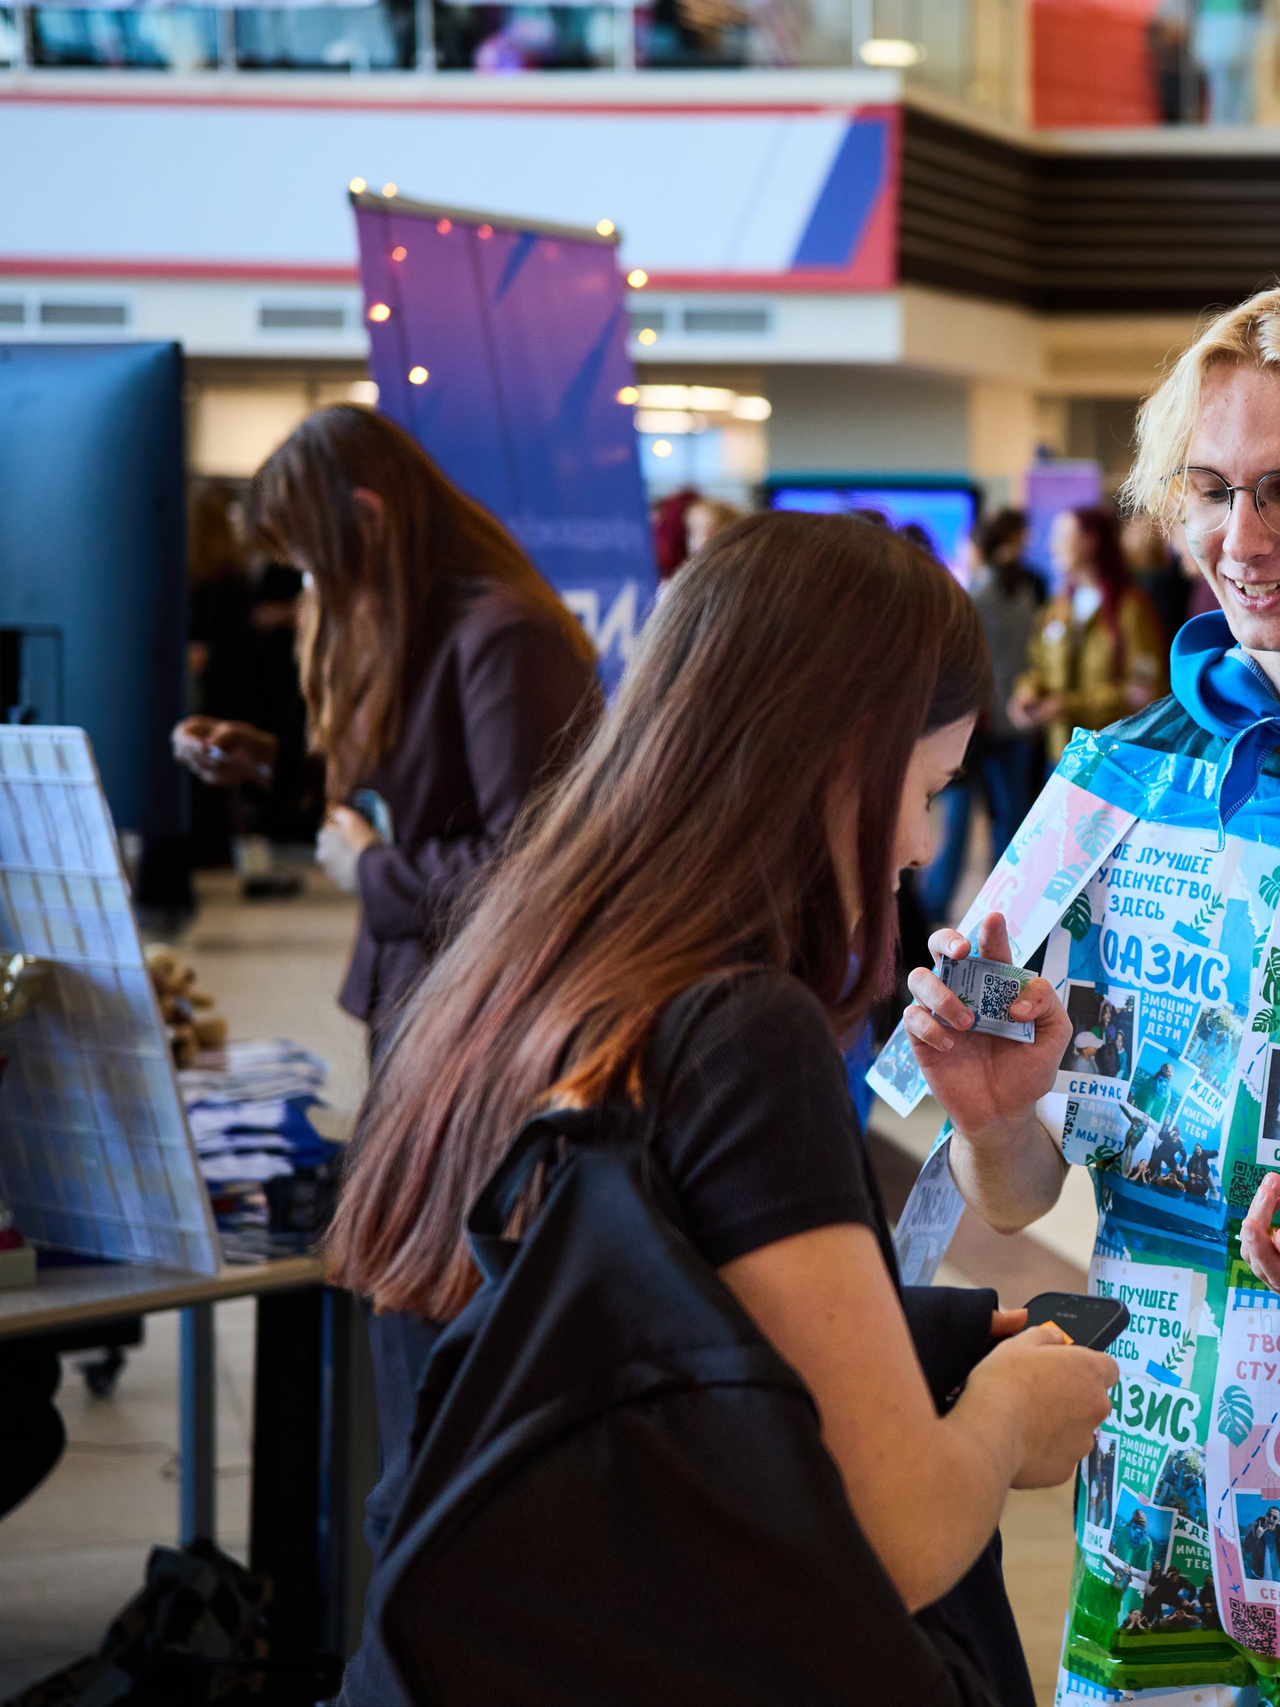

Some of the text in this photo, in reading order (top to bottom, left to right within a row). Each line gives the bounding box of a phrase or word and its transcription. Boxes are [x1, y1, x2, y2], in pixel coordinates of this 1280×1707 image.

[1111, 843, 1213, 875] ОЕ ЛУЧШЕЕ
[1098, 865, 1212, 901] УДЕНЧЕСТВО
[1109, 895, 1165, 921] ЗДЕСЬ
[1103, 929, 1223, 1001] ОАЗИС
[1141, 1005, 1190, 1029] РАБОТА
[1142, 992, 1194, 1017] ЭМОЦИИ
[1145, 1022, 1182, 1041] ДЕТИ
[1069, 1080, 1122, 1100] СЕЙЧАС
[1189, 1078, 1223, 1113] ЖДЕМ
[1182, 1105, 1218, 1130] ИМЕННО
[1075, 1128, 1124, 1151] МЫ ТУТ
[1184, 1121, 1208, 1141] ТЕБЯ
[1119, 1285, 1179, 1311] ЛУЧШЕЕ
[1109, 1378, 1194, 1443] АЗИС
[1121, 1436, 1160, 1460] ЭМОЦИИ
[1119, 1450, 1157, 1473] РАБОТА
[1122, 1466, 1149, 1486] ДЕТИ
[1174, 1517, 1209, 1543] ЖДЕ
[1185, 1558, 1210, 1570] ТЕБ
